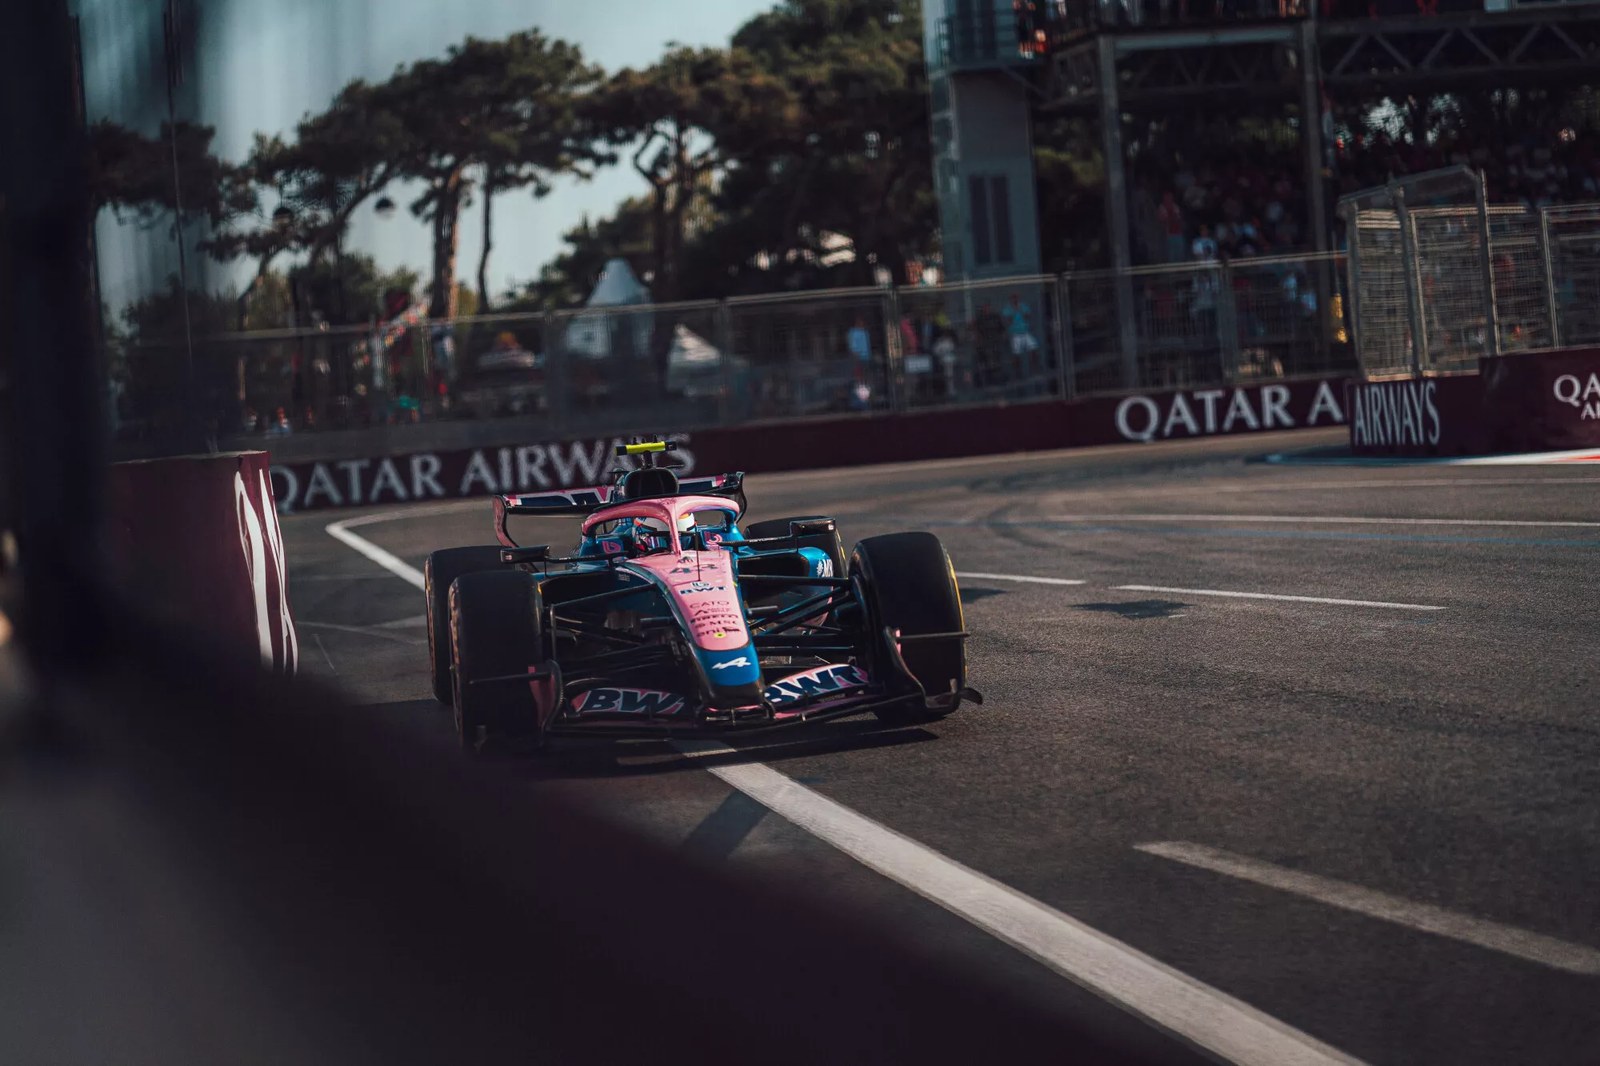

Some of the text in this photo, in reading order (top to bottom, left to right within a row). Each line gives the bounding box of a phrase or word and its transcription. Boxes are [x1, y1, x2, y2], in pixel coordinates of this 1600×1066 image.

[1114, 383, 1295, 442] QATAR
[1353, 381, 1440, 446] AIRWAYS
[272, 454, 443, 514] QATAR
[459, 432, 695, 494] AIRWAS
[576, 688, 687, 713] BW
[764, 664, 864, 703] BWT
